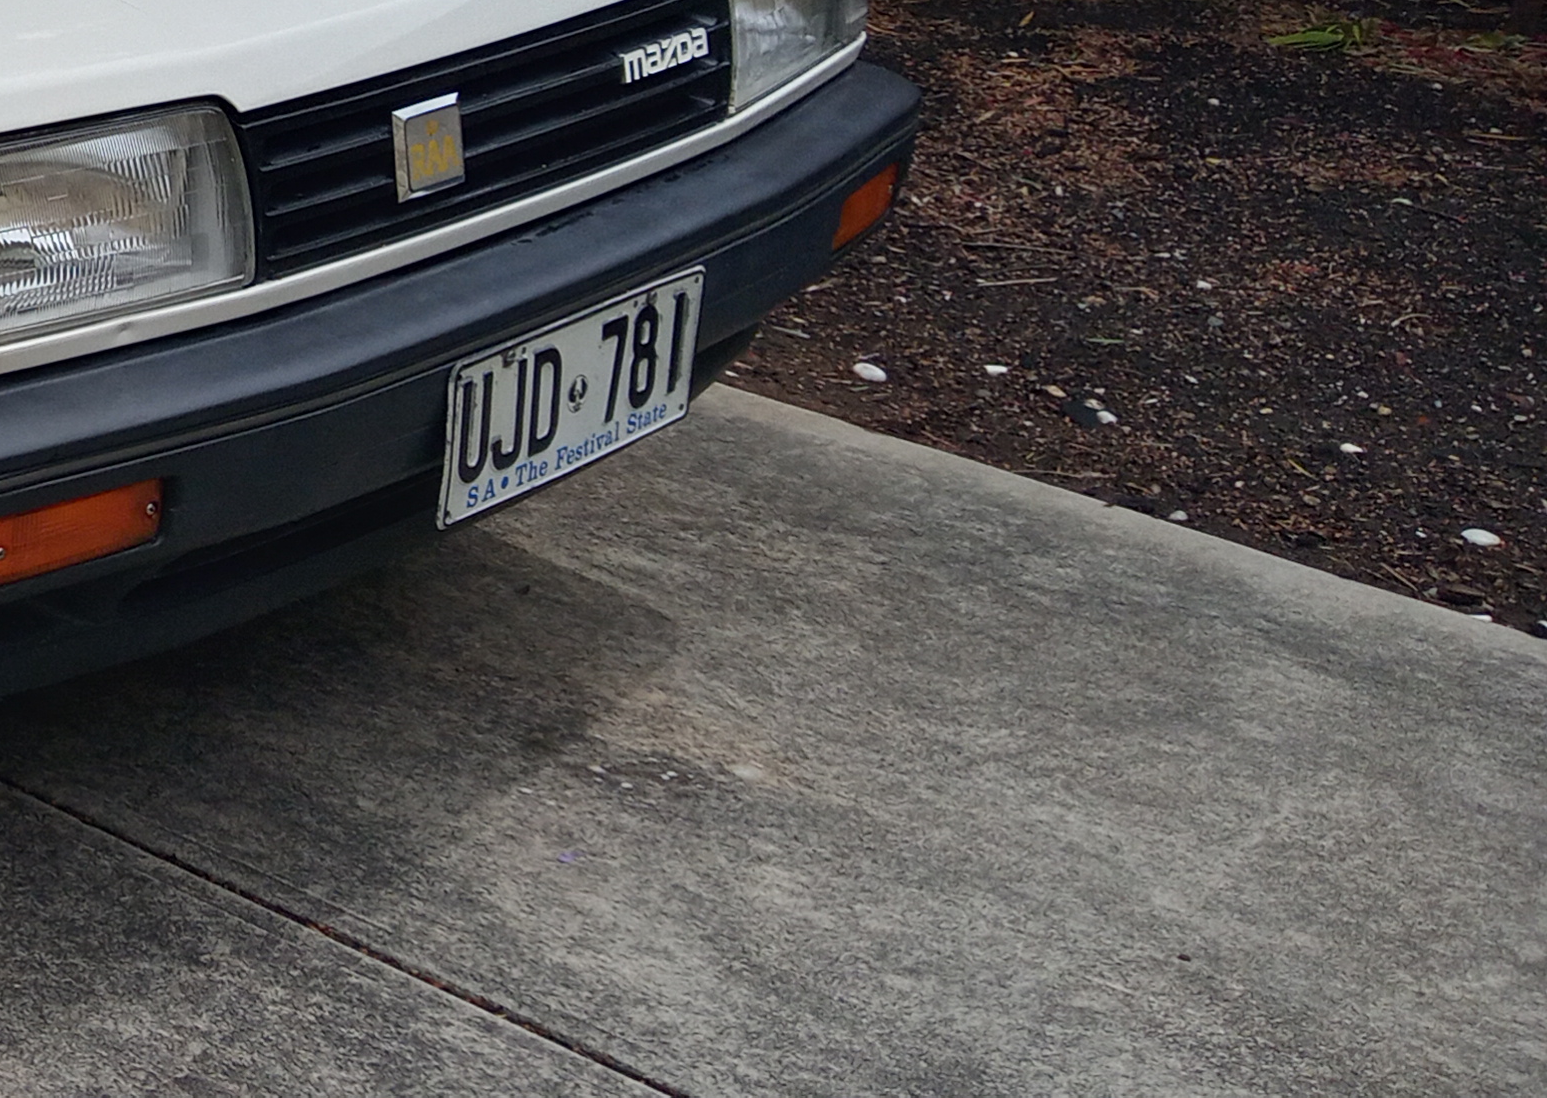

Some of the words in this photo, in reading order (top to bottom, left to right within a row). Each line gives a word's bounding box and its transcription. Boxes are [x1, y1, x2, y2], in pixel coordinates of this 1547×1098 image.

[458, 347, 562, 484] UJD
[601, 290, 688, 424] 781
[515, 460, 549, 487] The
[555, 421, 620, 471] Festival
[626, 403, 668, 434] State
